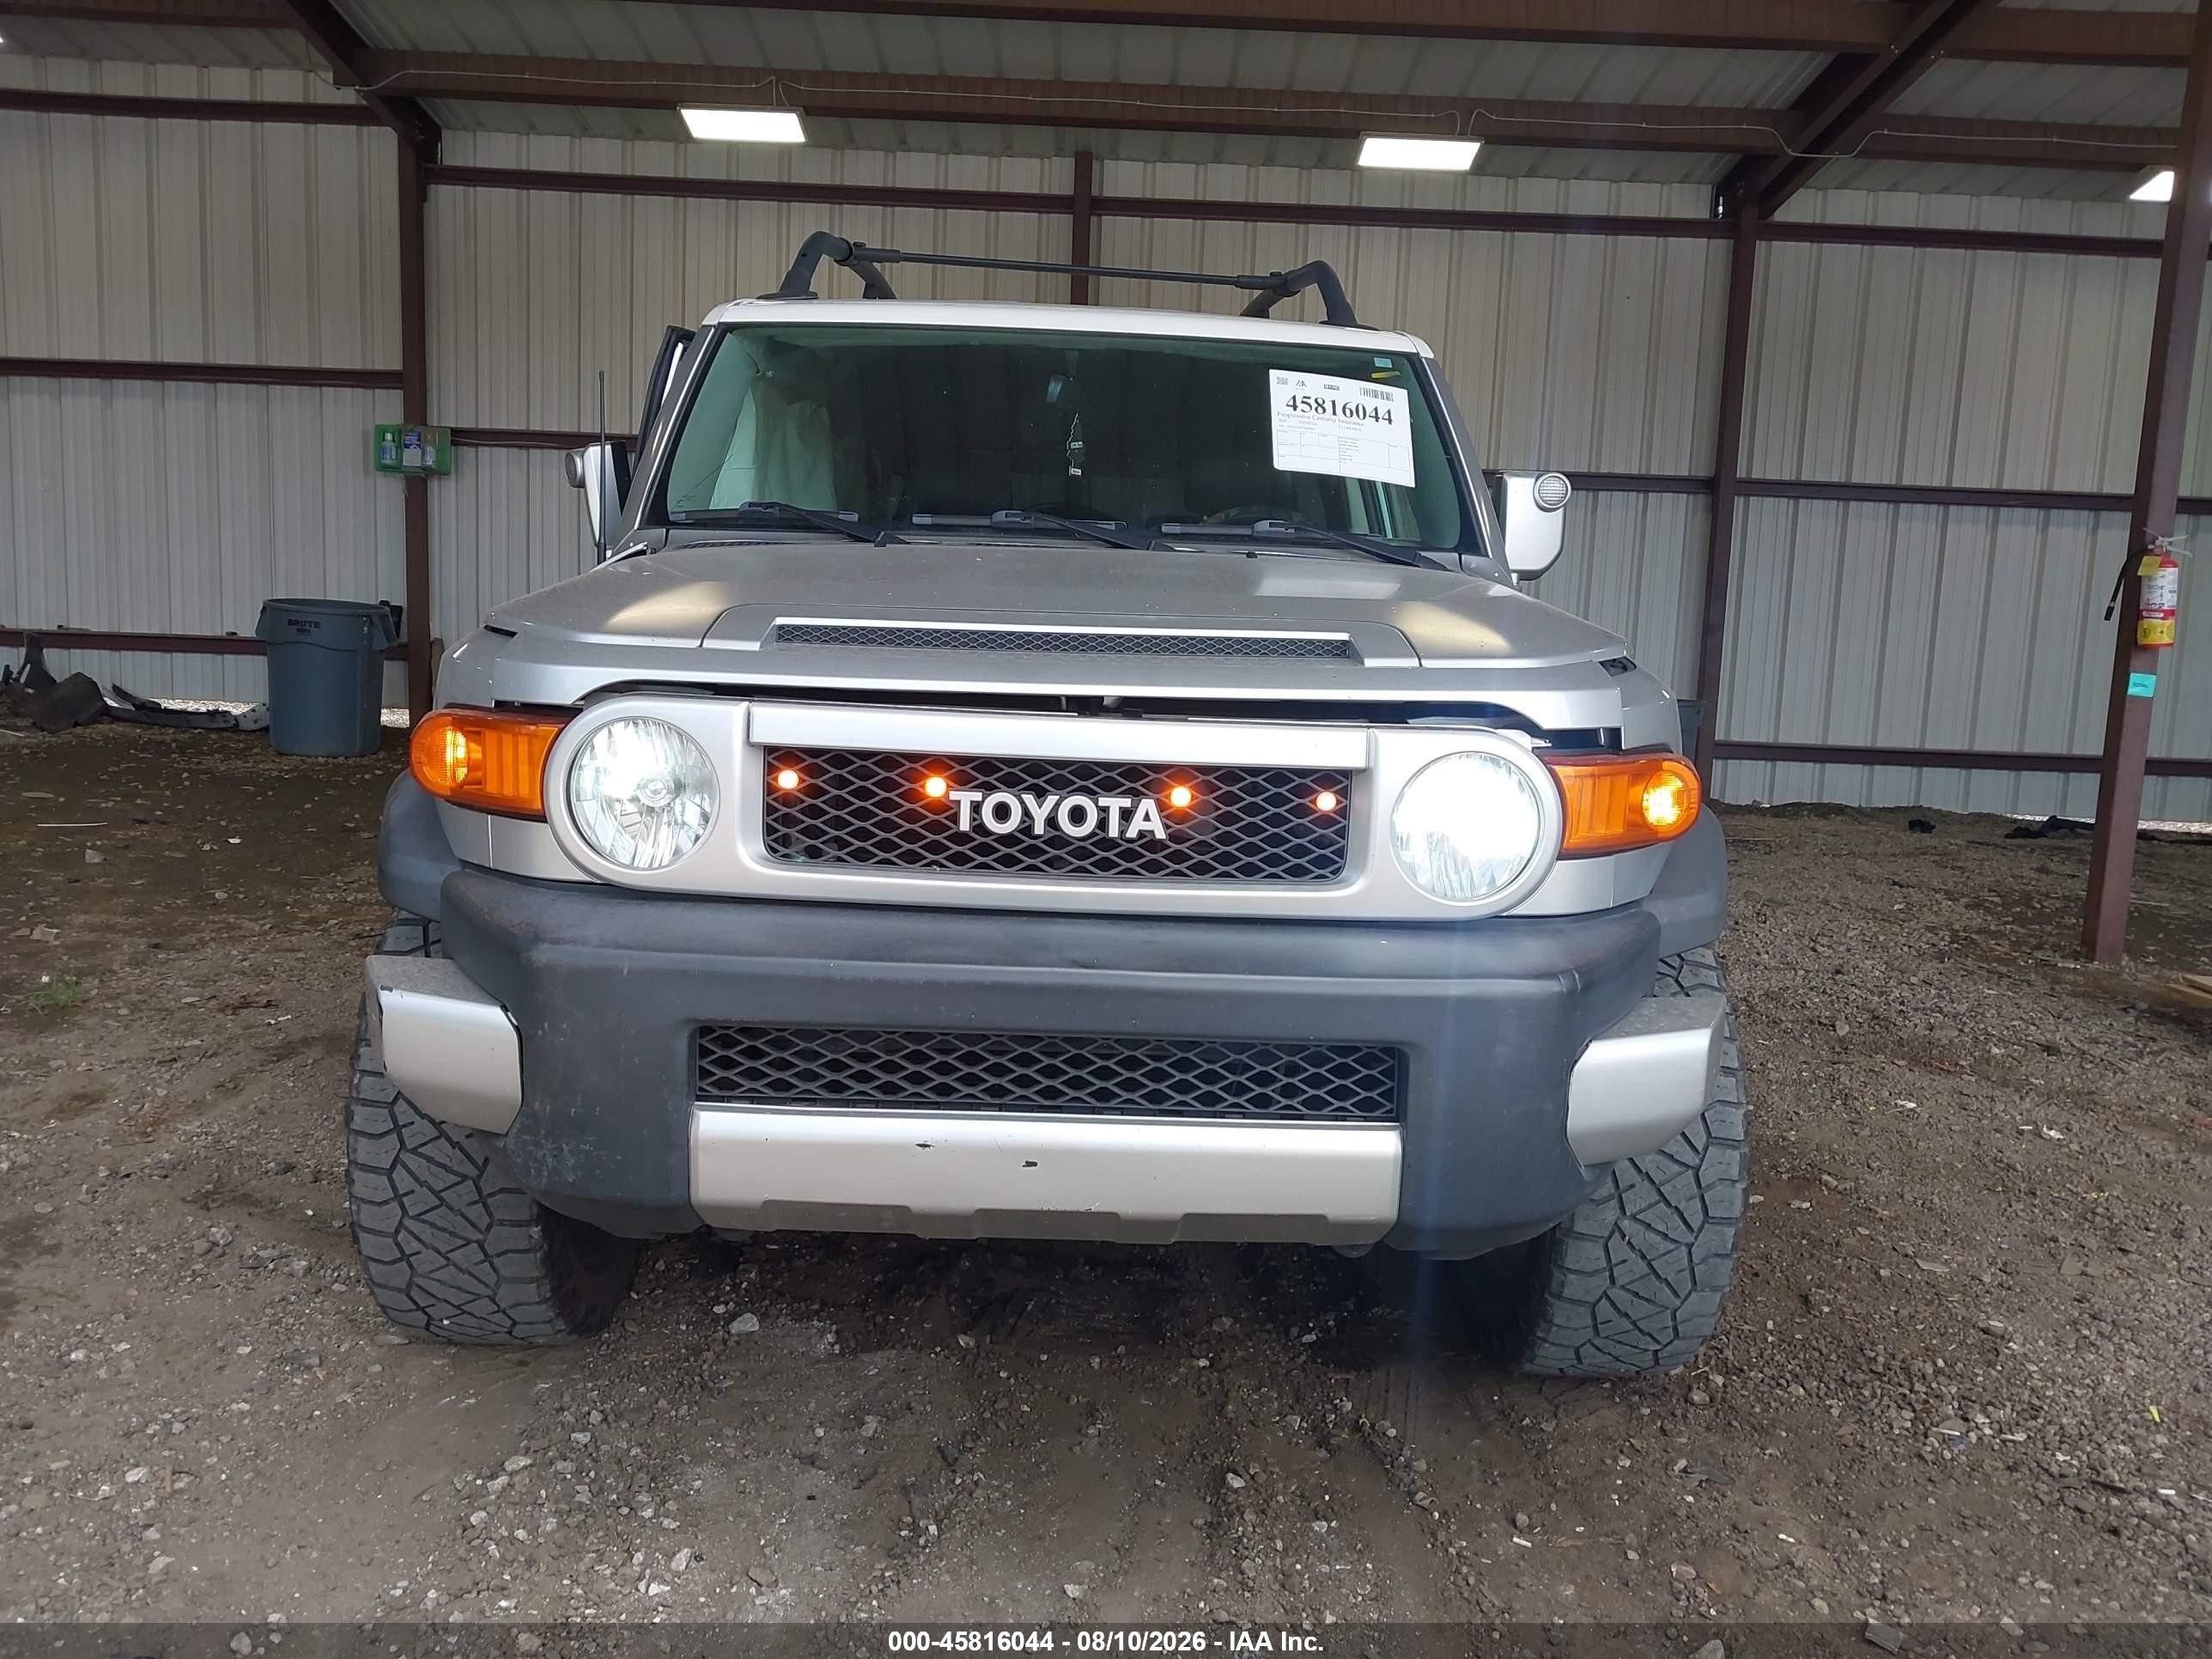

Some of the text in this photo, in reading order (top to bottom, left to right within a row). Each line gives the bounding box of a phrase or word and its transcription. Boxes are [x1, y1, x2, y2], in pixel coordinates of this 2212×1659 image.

[1277, 411, 1311, 420] Progressive
[1285, 394, 1394, 425] 45816044
[288, 618, 320, 629] BRUTE
[948, 790, 1166, 840] TOYOTA
